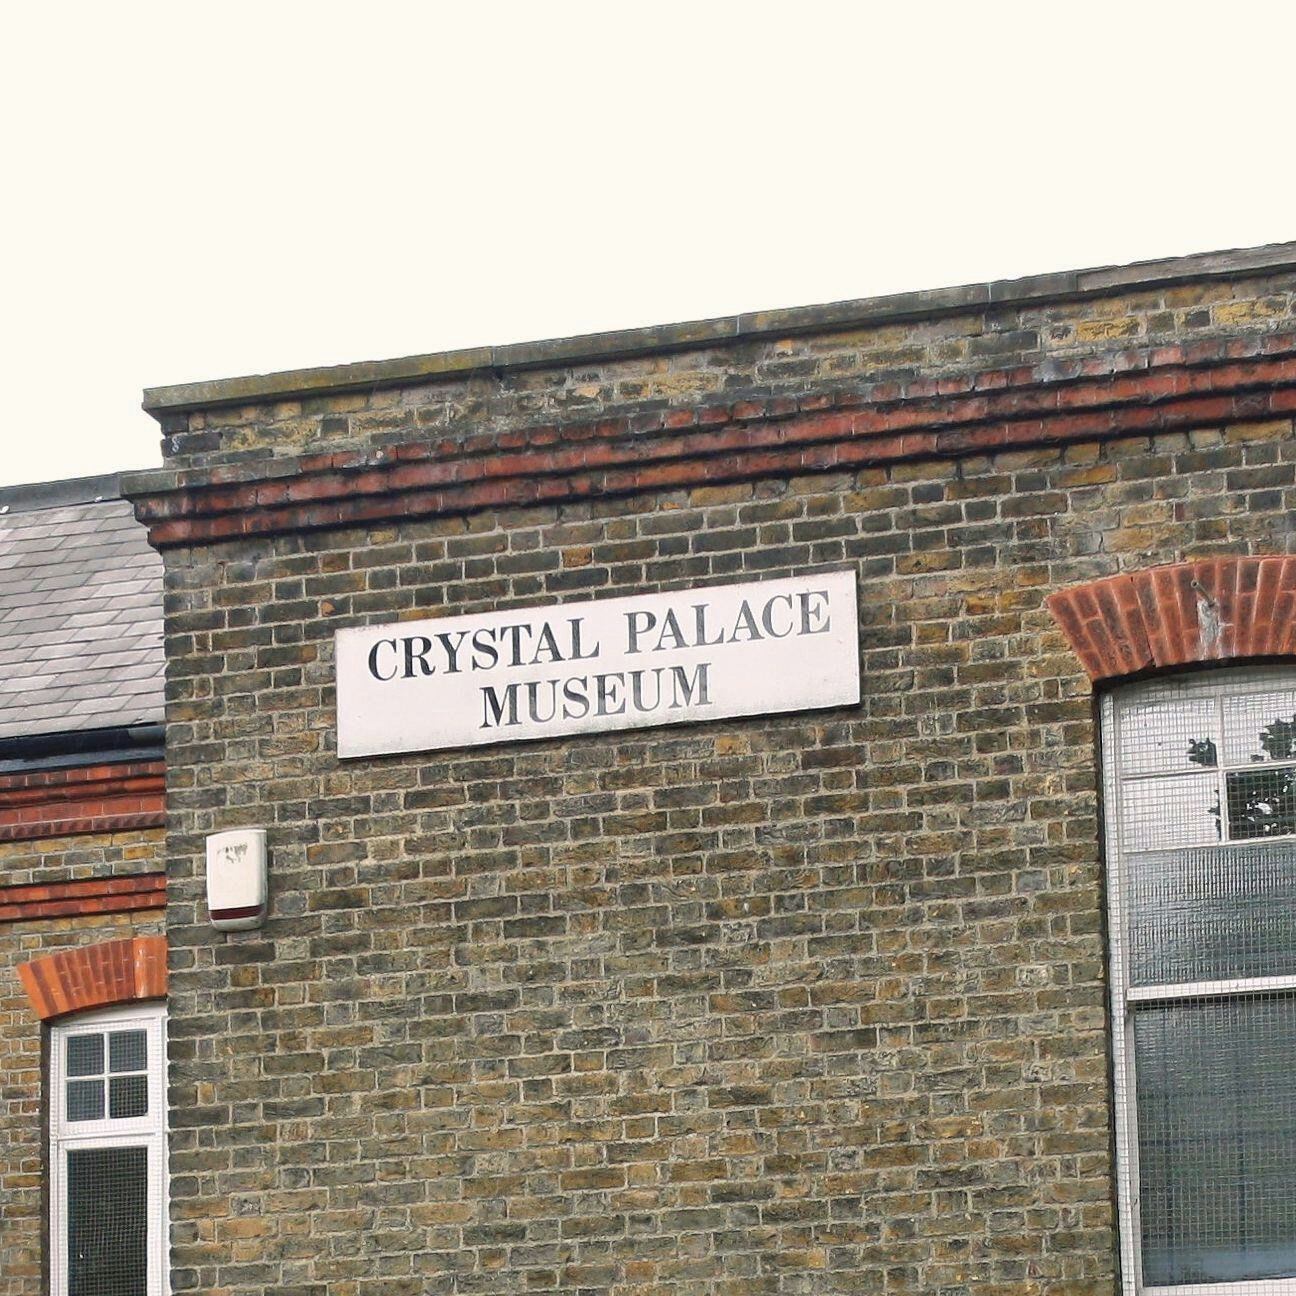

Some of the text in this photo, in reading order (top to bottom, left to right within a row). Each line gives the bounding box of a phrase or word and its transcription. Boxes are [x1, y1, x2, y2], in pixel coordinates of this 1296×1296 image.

[367, 589, 832, 682] CRYSTAL PALACE
[478, 662, 714, 730] MUSEUM
